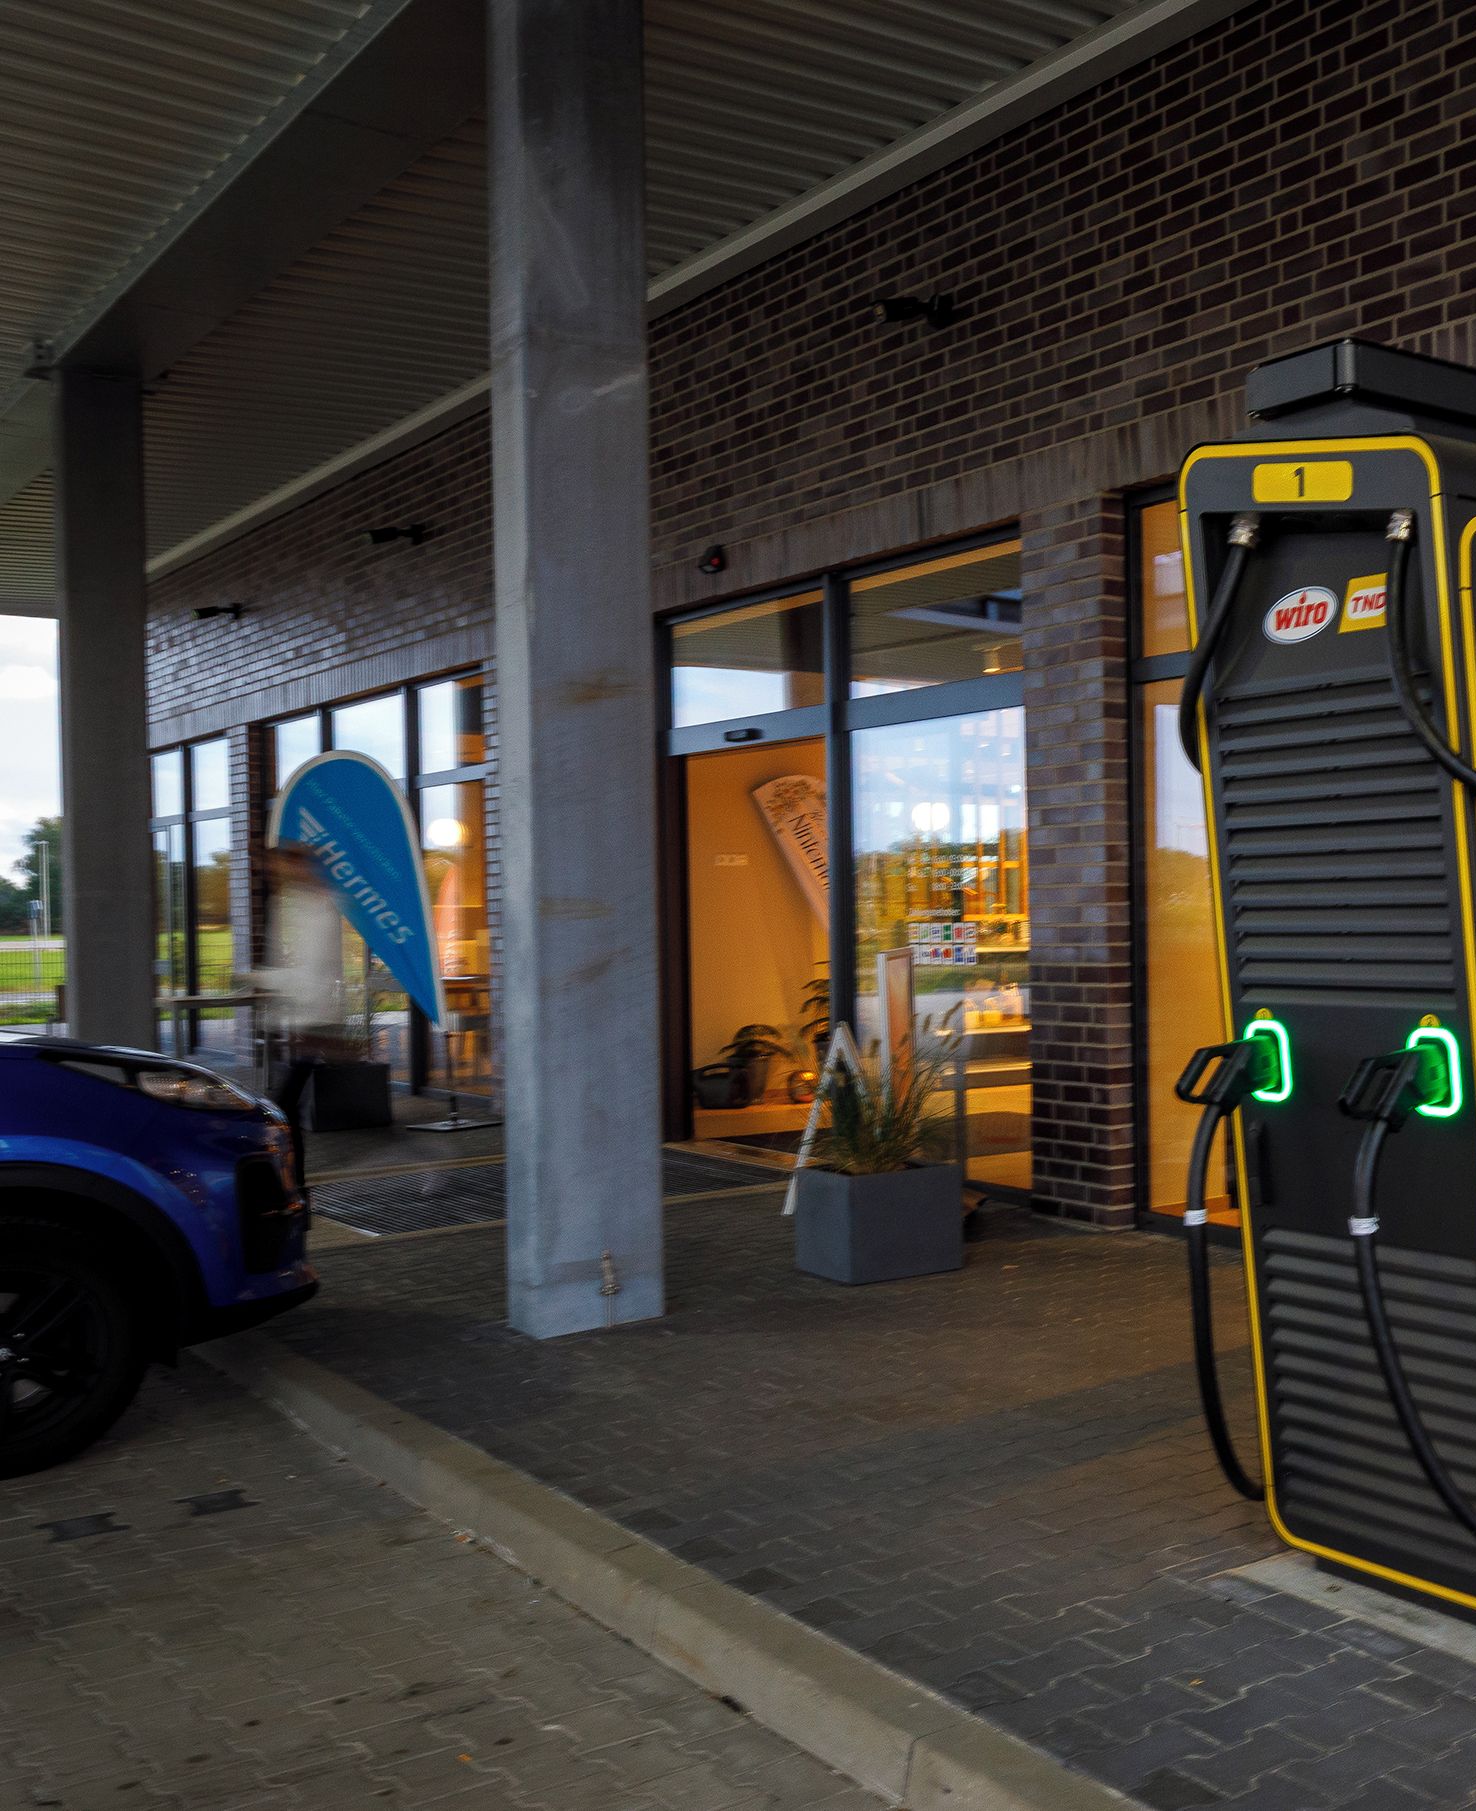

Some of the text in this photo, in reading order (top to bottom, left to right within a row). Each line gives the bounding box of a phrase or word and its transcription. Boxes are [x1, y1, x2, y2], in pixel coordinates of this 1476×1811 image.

[1294, 466, 1305, 497] 1
[1274, 591, 1330, 632] wiro
[1351, 591, 1387, 614] TND
[314, 839, 416, 945] Hermes
